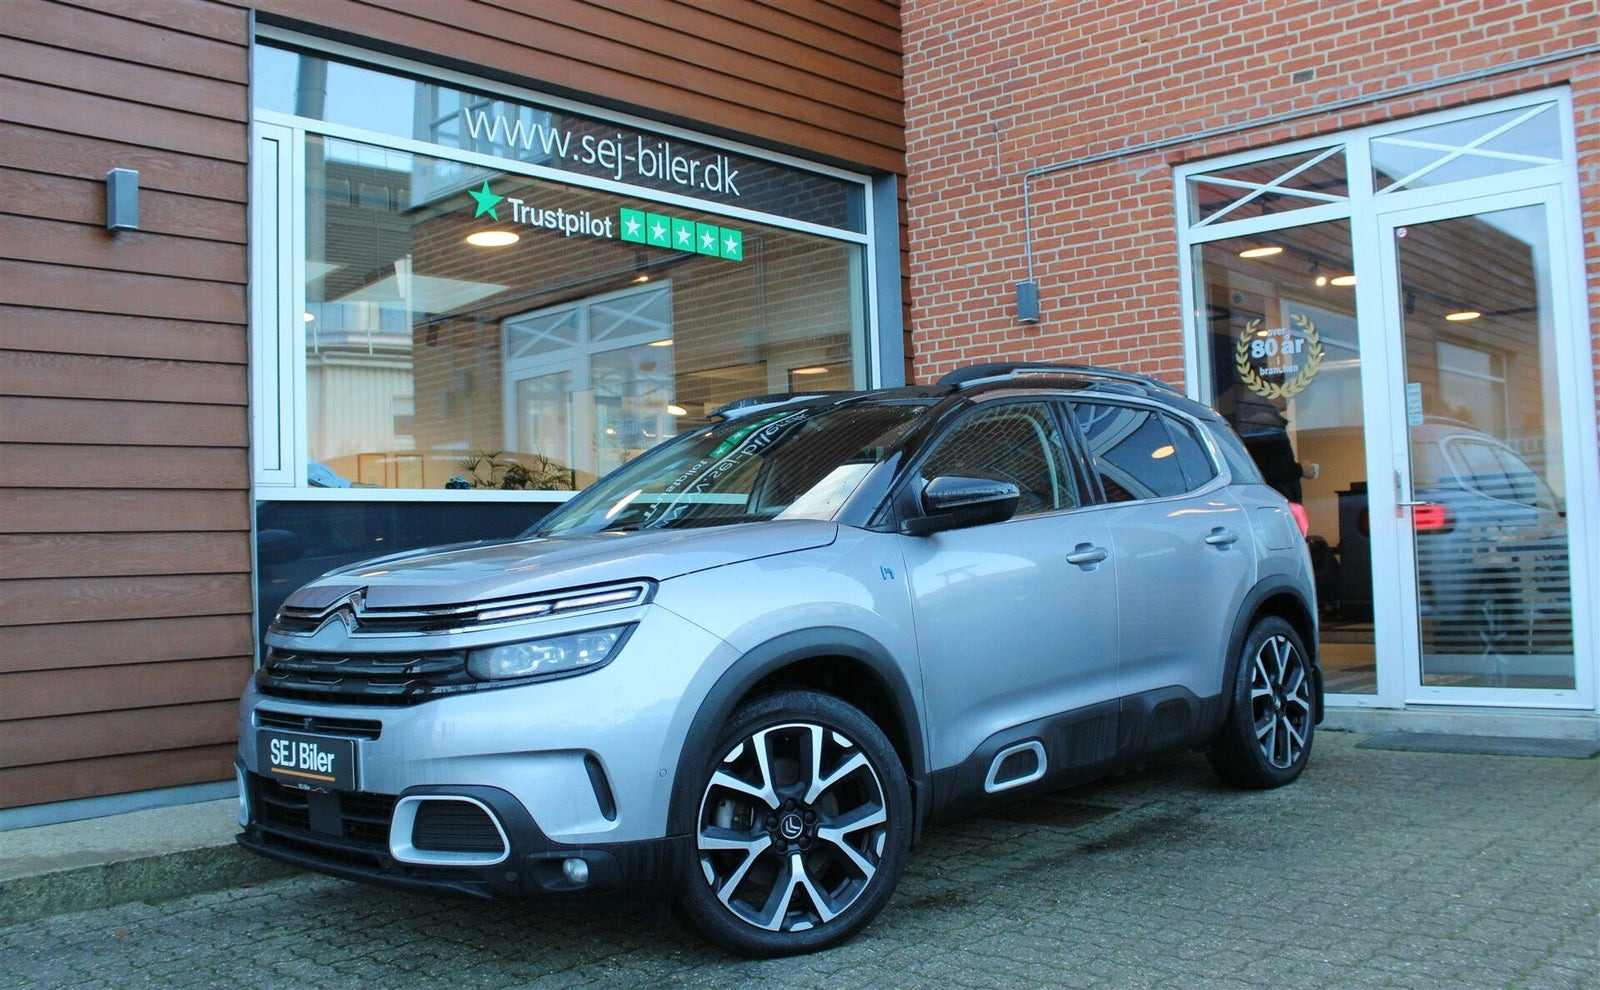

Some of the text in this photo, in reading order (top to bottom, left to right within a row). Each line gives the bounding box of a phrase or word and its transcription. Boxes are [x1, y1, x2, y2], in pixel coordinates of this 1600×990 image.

[464, 107, 740, 197] www.sej-biler.dk
[507, 197, 613, 239] Trustpilot
[1267, 327, 1286, 336] over
[1251, 335, 1305, 358] 80 år
[1259, 364, 1299, 376] branchen
[270, 738, 335, 773] SEJ Biler
